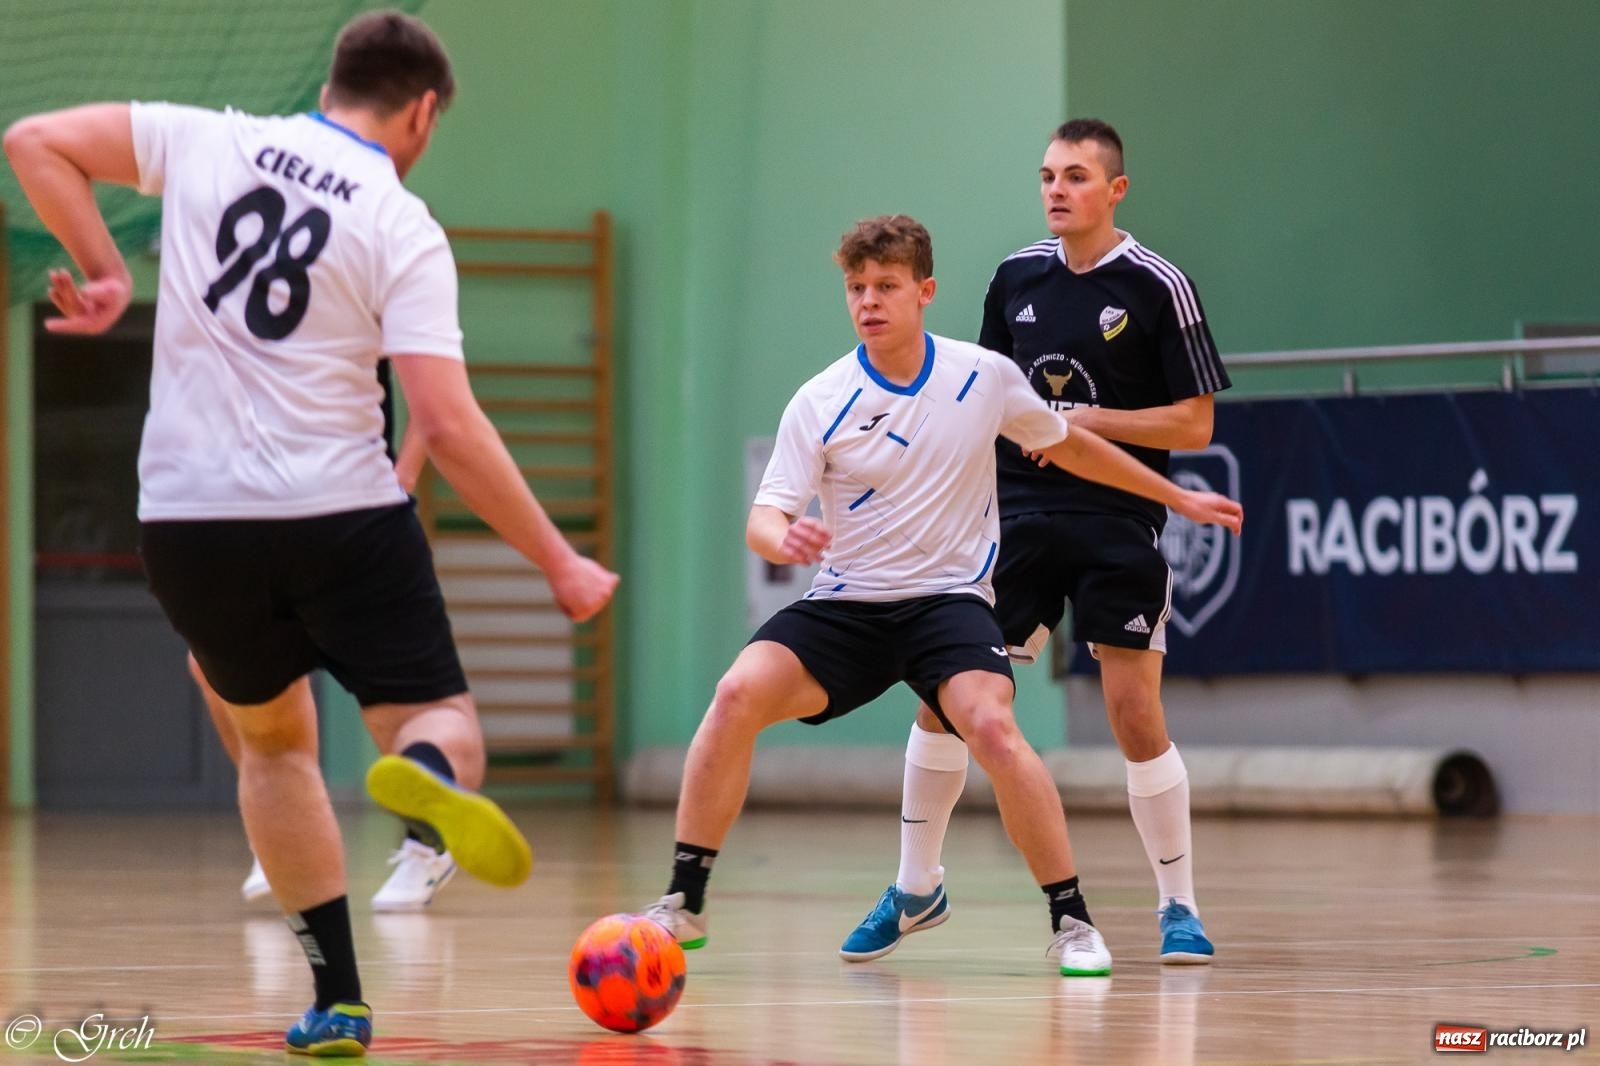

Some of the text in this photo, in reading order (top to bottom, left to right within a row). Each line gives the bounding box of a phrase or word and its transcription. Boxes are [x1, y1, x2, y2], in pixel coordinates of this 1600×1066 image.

[255, 147, 361, 202] CIELAK
[203, 185, 331, 341] 98
[1286, 468, 1578, 576] RACIBÓRZ
[1124, 623, 1151, 634] adidas
